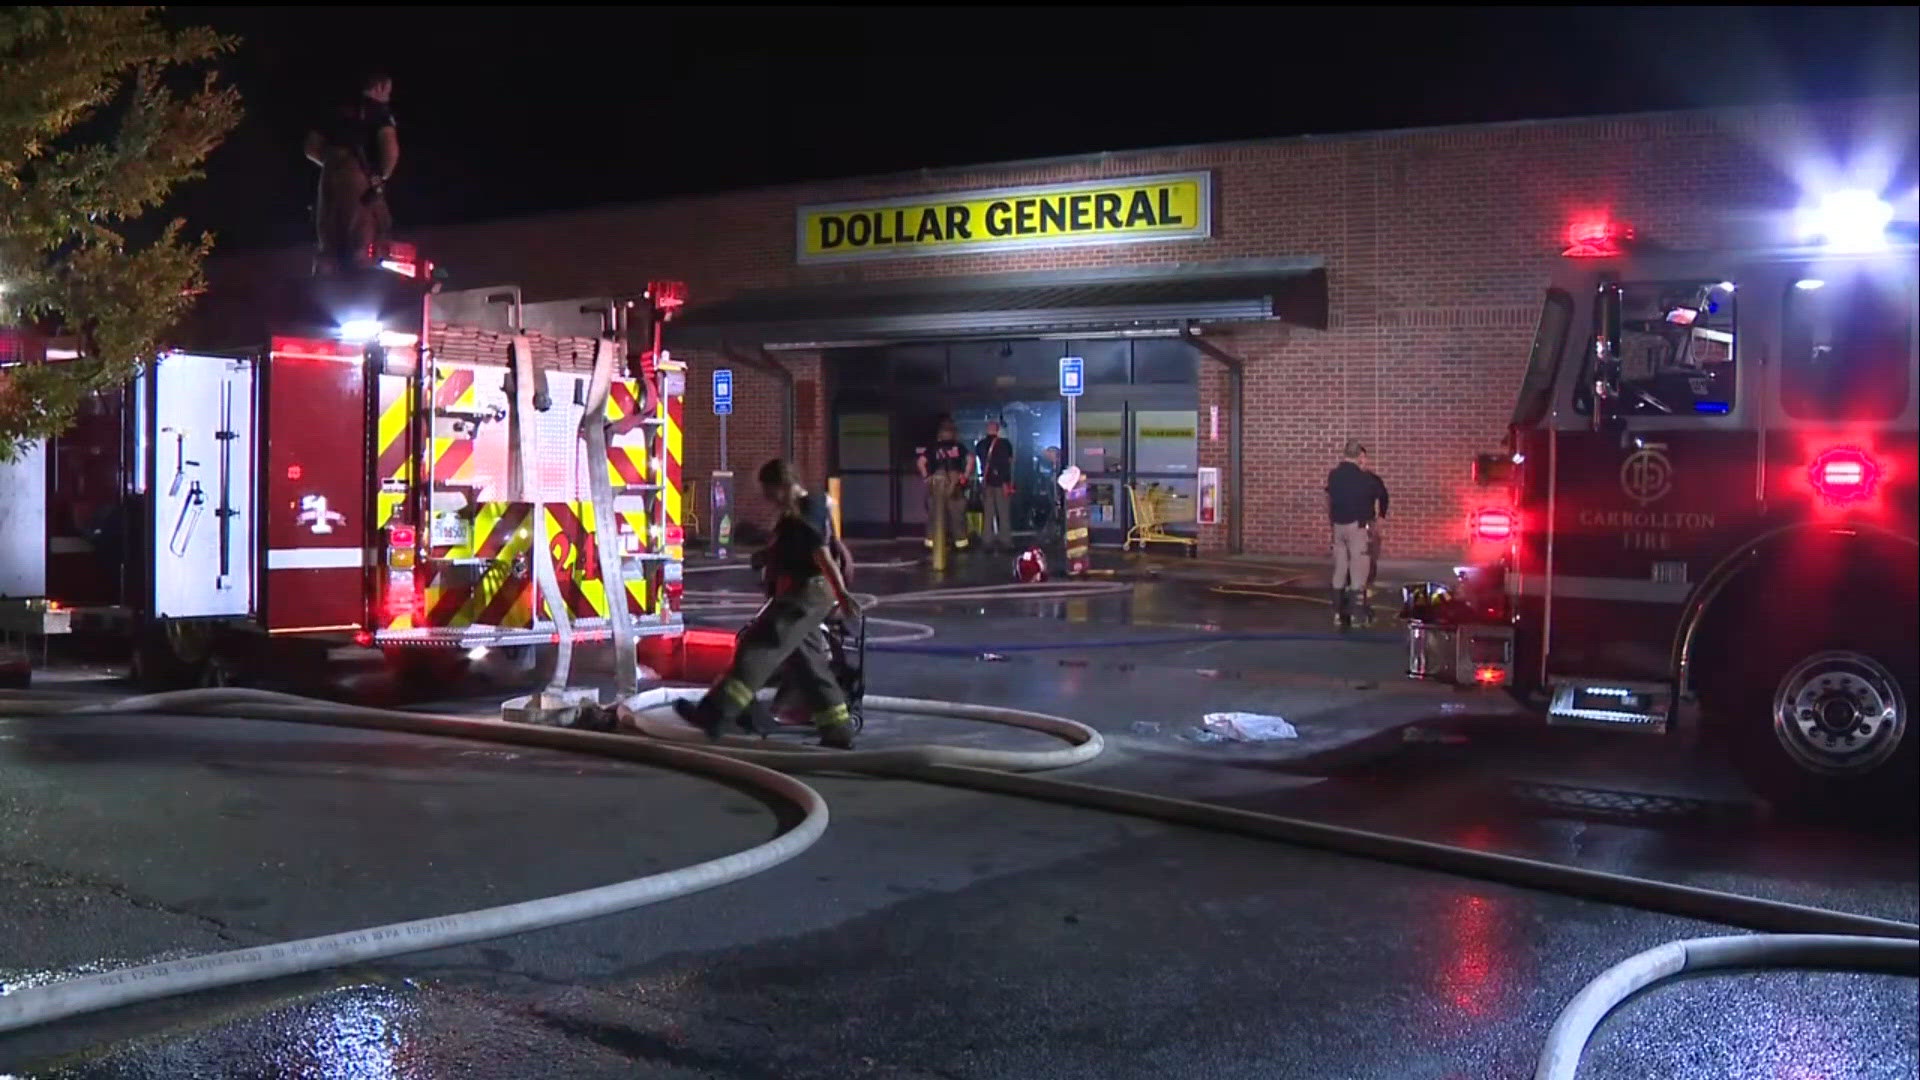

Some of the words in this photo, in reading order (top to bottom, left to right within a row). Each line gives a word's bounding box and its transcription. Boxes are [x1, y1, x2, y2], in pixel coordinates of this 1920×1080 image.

[819, 204, 971, 249] DOLLAR
[985, 188, 1183, 236] GENERAL
[1579, 510, 1716, 529] CARROLLTON
[1623, 532, 1671, 550] FIRE
